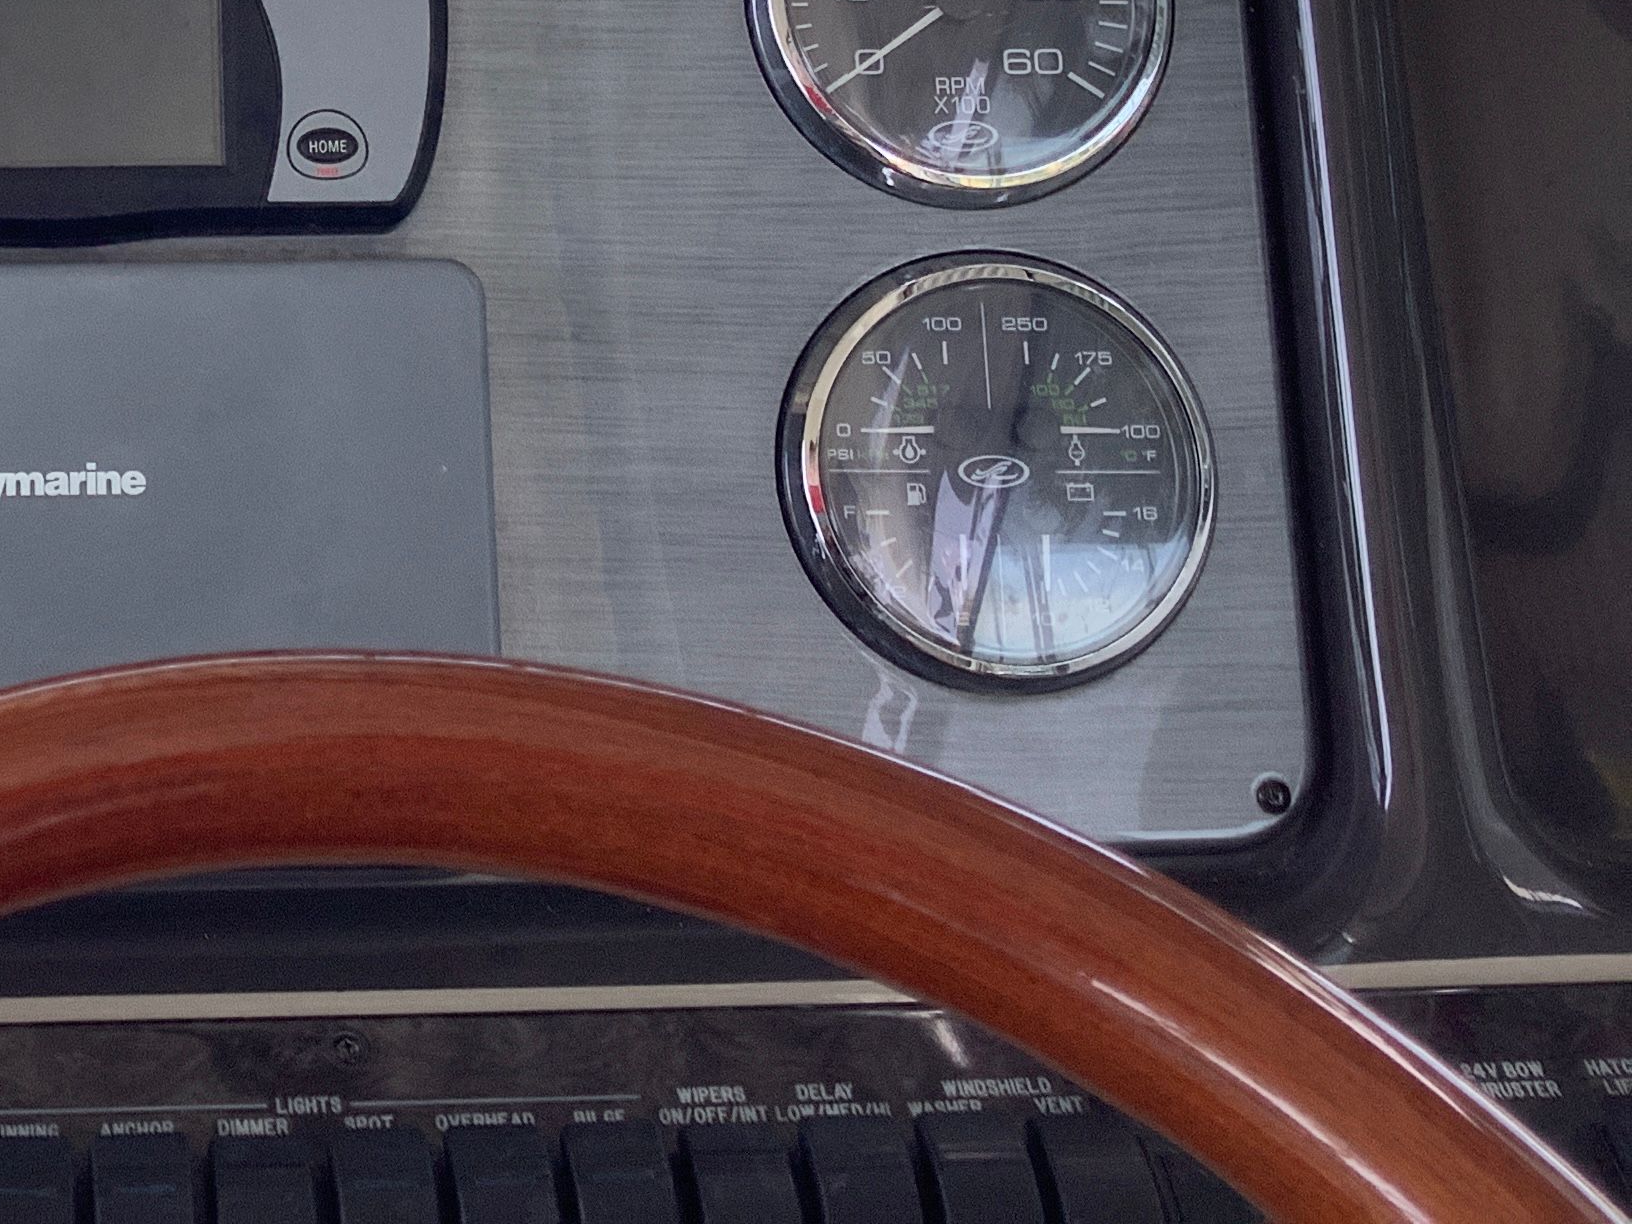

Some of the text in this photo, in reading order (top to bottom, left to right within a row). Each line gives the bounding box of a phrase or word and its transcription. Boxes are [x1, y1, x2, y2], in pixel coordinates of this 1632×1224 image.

[854, 49, 885, 75] 0
[1003, 49, 1063, 75] 60
[935, 77, 985, 95] RPM
[934, 96, 991, 114] X100
[309, 140, 347, 153] HOME
[922, 317, 962, 332] 100
[1001, 317, 1048, 332] 250
[862, 351, 892, 366] 50
[1075, 351, 1112, 366] 175
[836, 423, 851, 438] 0
[1121, 424, 1161, 439] 100
[843, 506, 857, 520] F
[1132, 507, 1159, 521] 16
[1502, 1060, 1544, 1078] BOW
[677, 1086, 746, 1103] WIPERS
[795, 1083, 853, 1102] DELAY
[941, 1077, 1052, 1097] WINDSHIELD
[274, 1096, 343, 1116] LIGHTS
[1033, 1095, 1084, 1116] VENT
[658, 1105, 768, 1125] ON/OFF/INT
[217, 1118, 289, 1137] DIMMER
